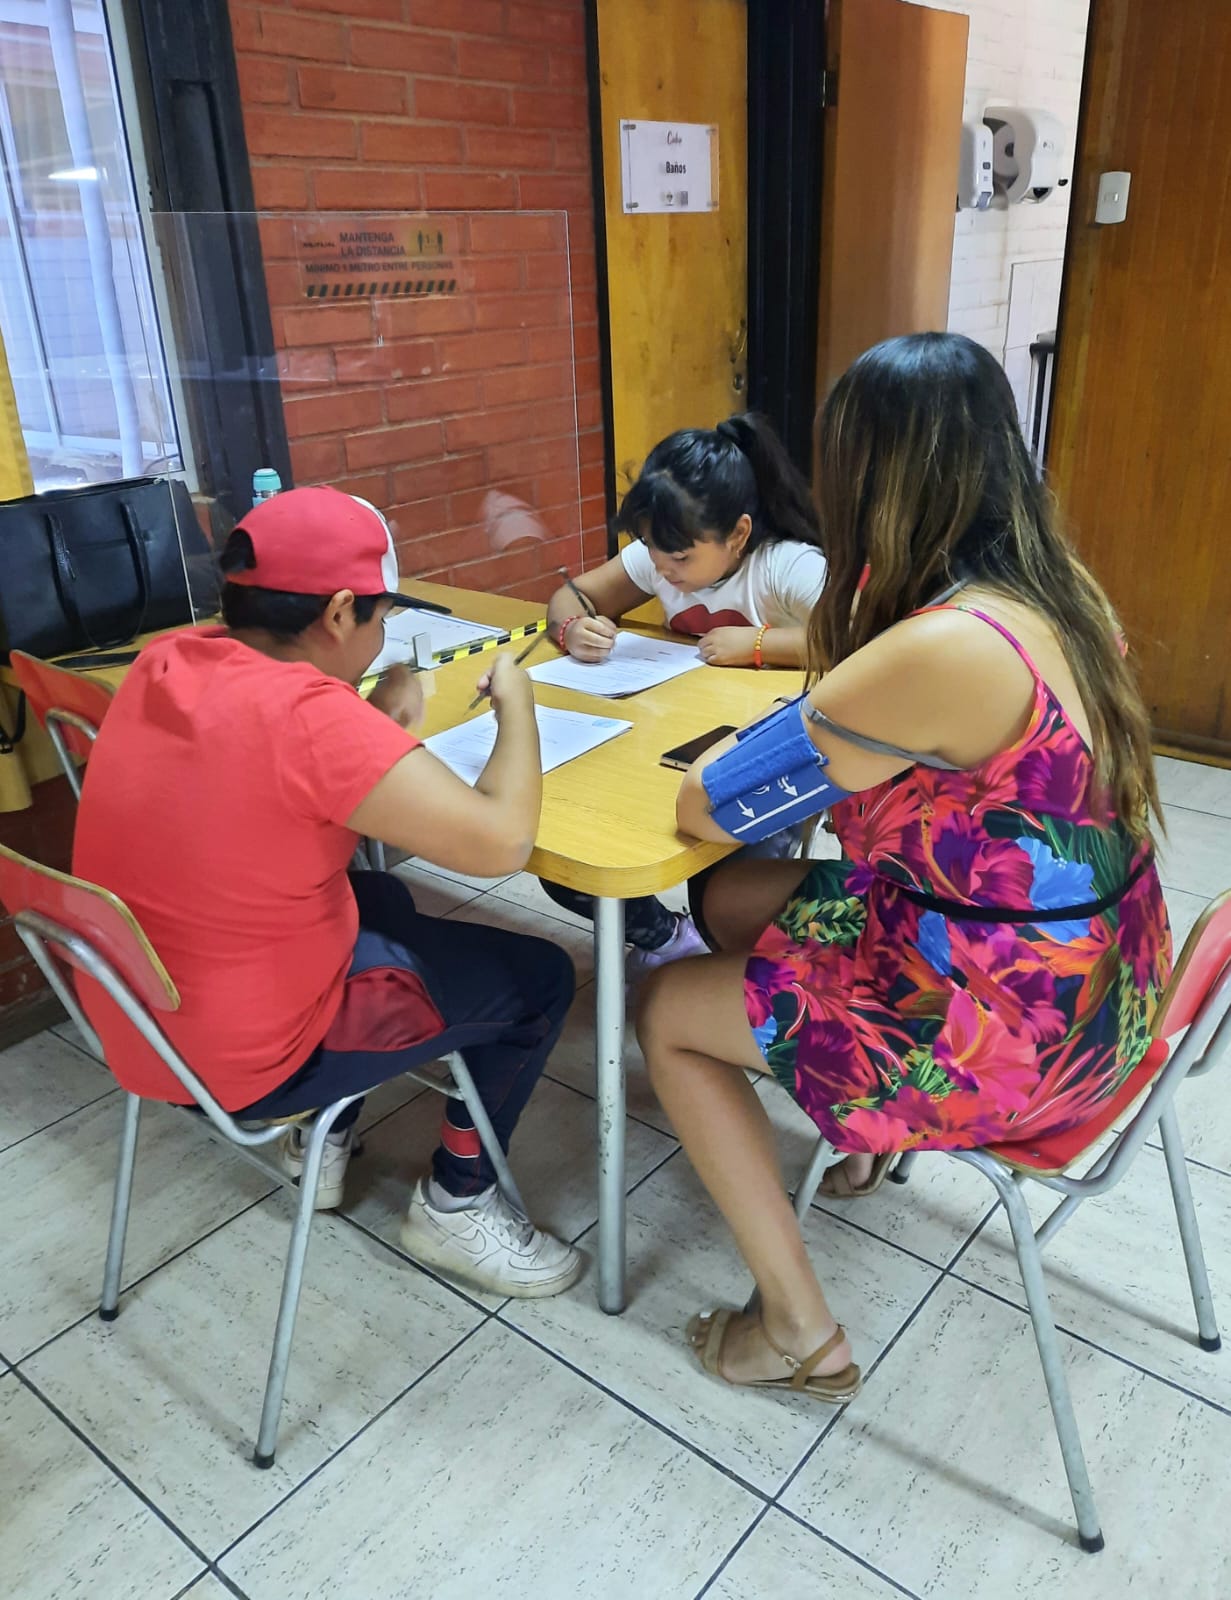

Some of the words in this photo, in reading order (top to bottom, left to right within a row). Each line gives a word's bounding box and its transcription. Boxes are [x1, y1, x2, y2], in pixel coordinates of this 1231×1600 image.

[665, 161, 686, 174] Baños
[340, 232, 394, 243] MANTENGA
[340, 247, 354, 257] LA
[356, 246, 405, 257] DISTANCIA
[350, 263, 381, 272] METRO
[382, 261, 409, 271] ENTRE
